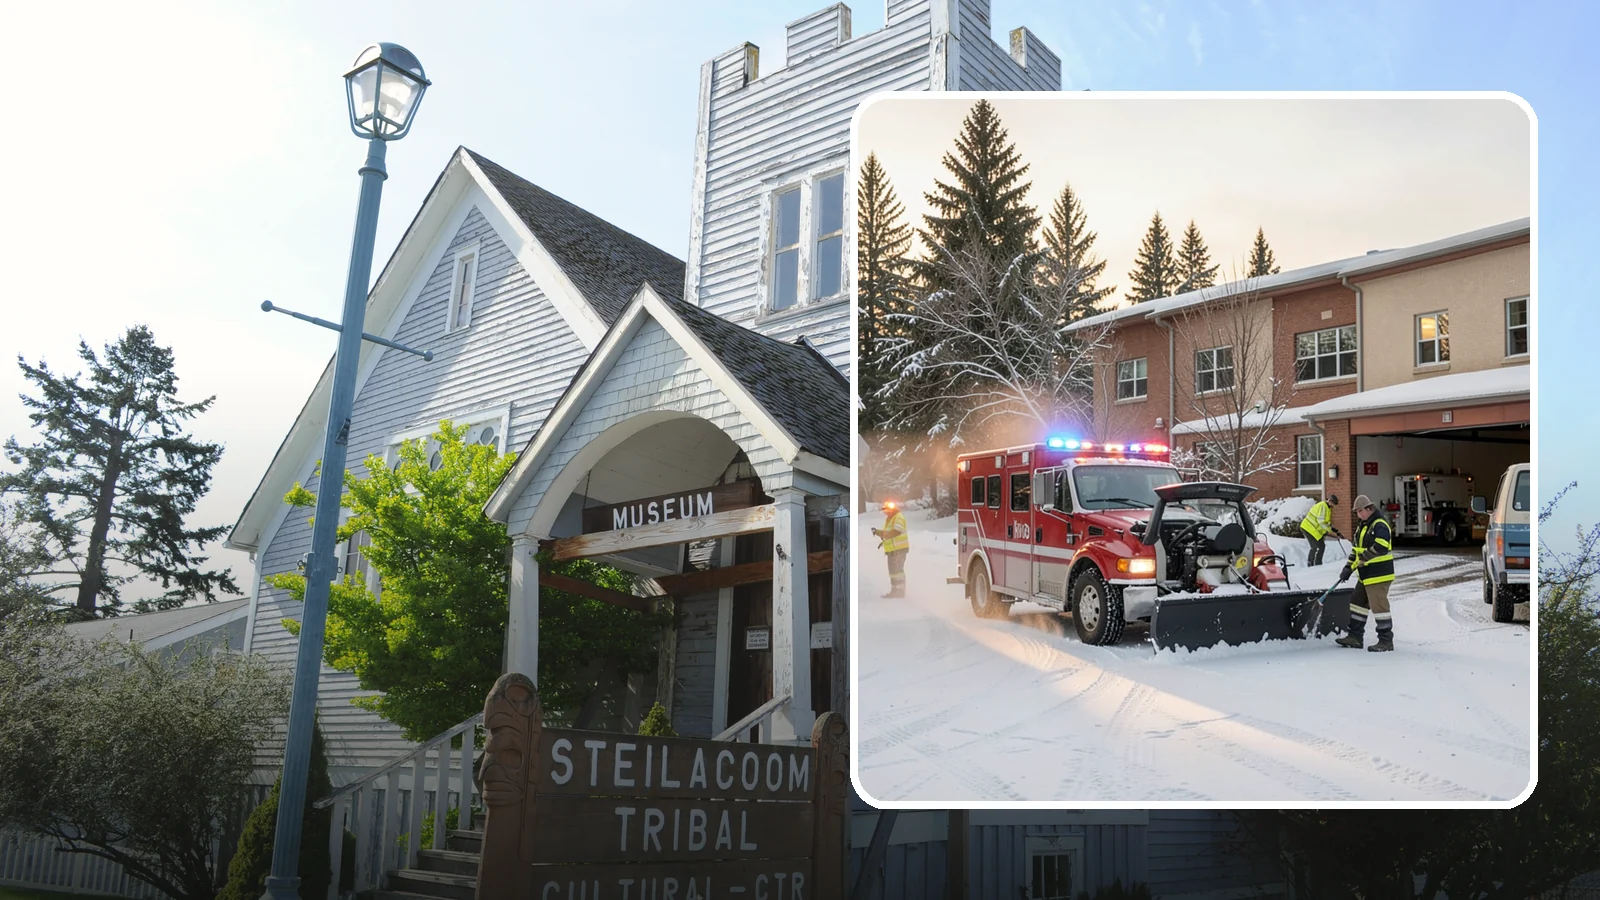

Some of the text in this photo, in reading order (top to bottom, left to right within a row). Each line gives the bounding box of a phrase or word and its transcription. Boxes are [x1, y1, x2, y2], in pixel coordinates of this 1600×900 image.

[613, 491, 714, 531] MUSEUM
[550, 738, 810, 793] STEILACOOM
[614, 806, 758, 852] TRIBAL
